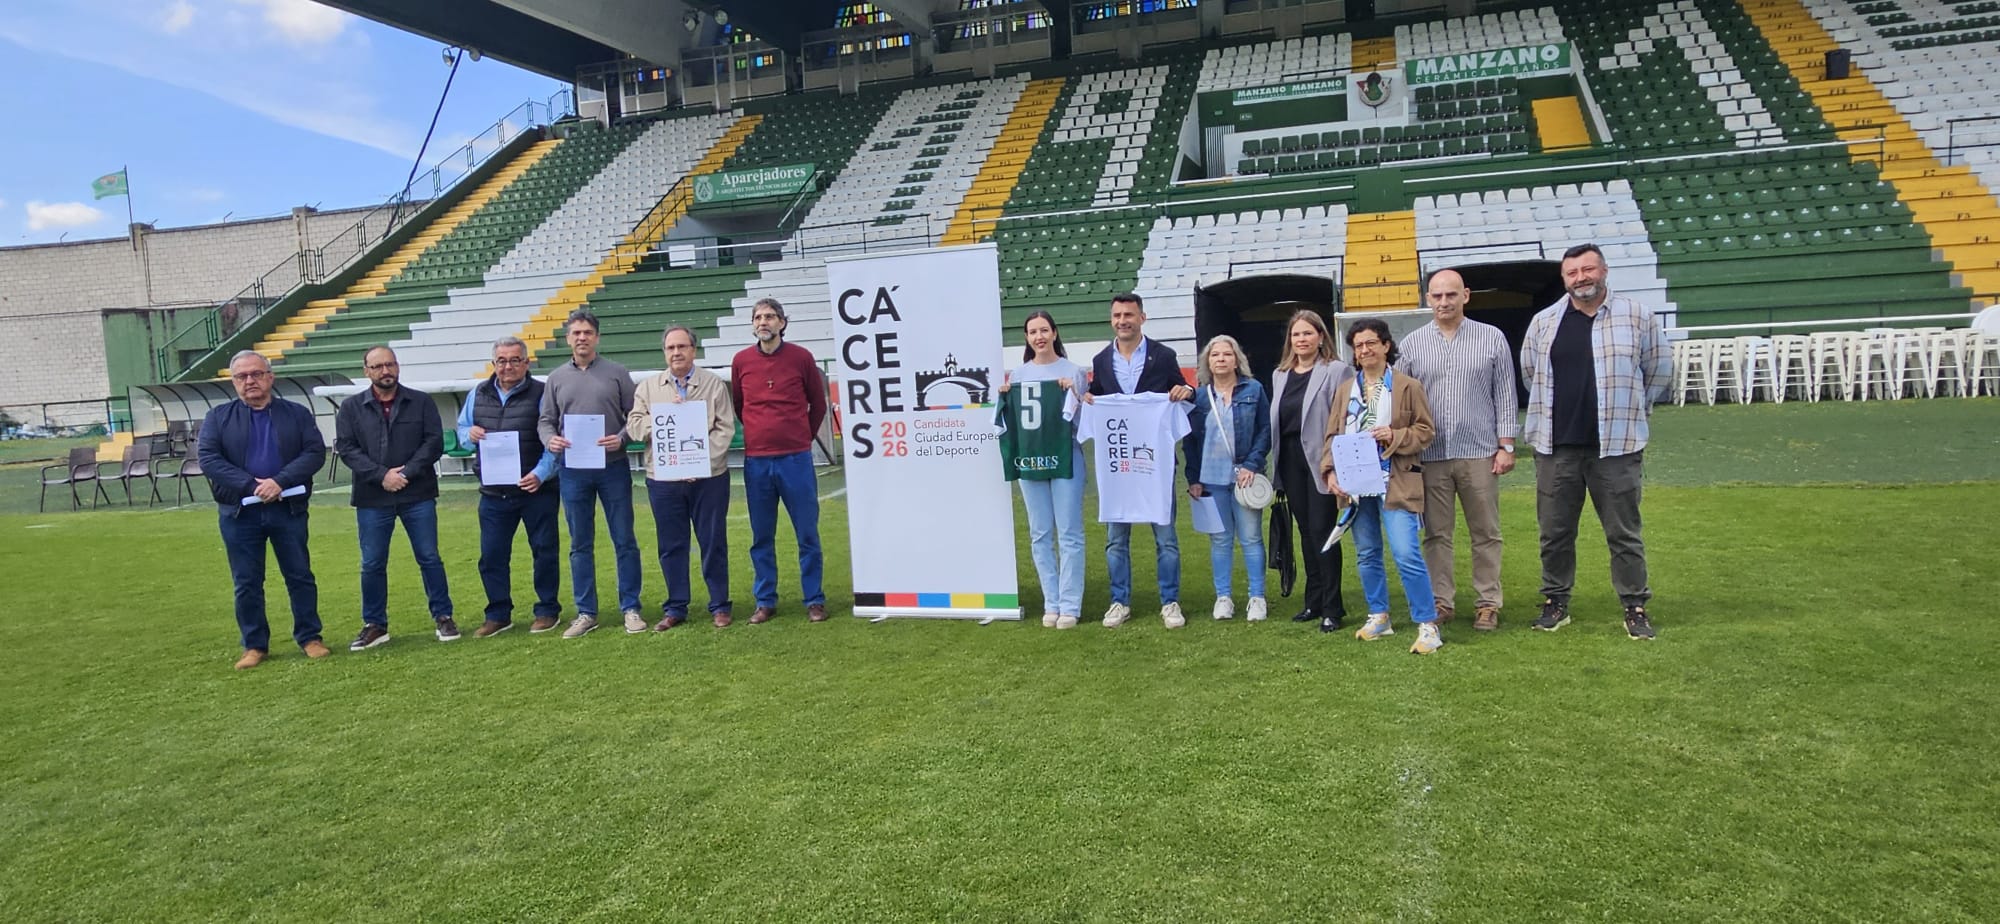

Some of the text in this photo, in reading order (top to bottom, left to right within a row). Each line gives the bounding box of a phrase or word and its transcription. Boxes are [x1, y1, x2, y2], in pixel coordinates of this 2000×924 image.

[1416, 45, 1560, 76] MANZANO
[1416, 70, 1486, 83] CERÁMICA
[1513, 62, 1560, 74] BAÑOS
[1237, 86, 1287, 98] MANZANO
[1292, 79, 1342, 92] MANZANO
[720, 167, 807, 188] Aparejadores
[838, 285, 902, 325] CÁ
[842, 332, 901, 371] CE
[847, 377, 904, 414] RE
[1021, 381, 1042, 430] 5
[880, 421, 907, 438] 20
[914, 417, 966, 429] Candidata
[656, 428, 676, 440] CE
[852, 422, 874, 459] S
[915, 432, 953, 443] Ciudad
[1107, 433, 1128, 445] CE
[657, 441, 677, 453] RE
[882, 441, 908, 457] 26
[916, 445, 980, 459] del Deporte
[1109, 447, 1128, 459] RE
[658, 455, 666, 466] S
[1110, 461, 1118, 473] S
